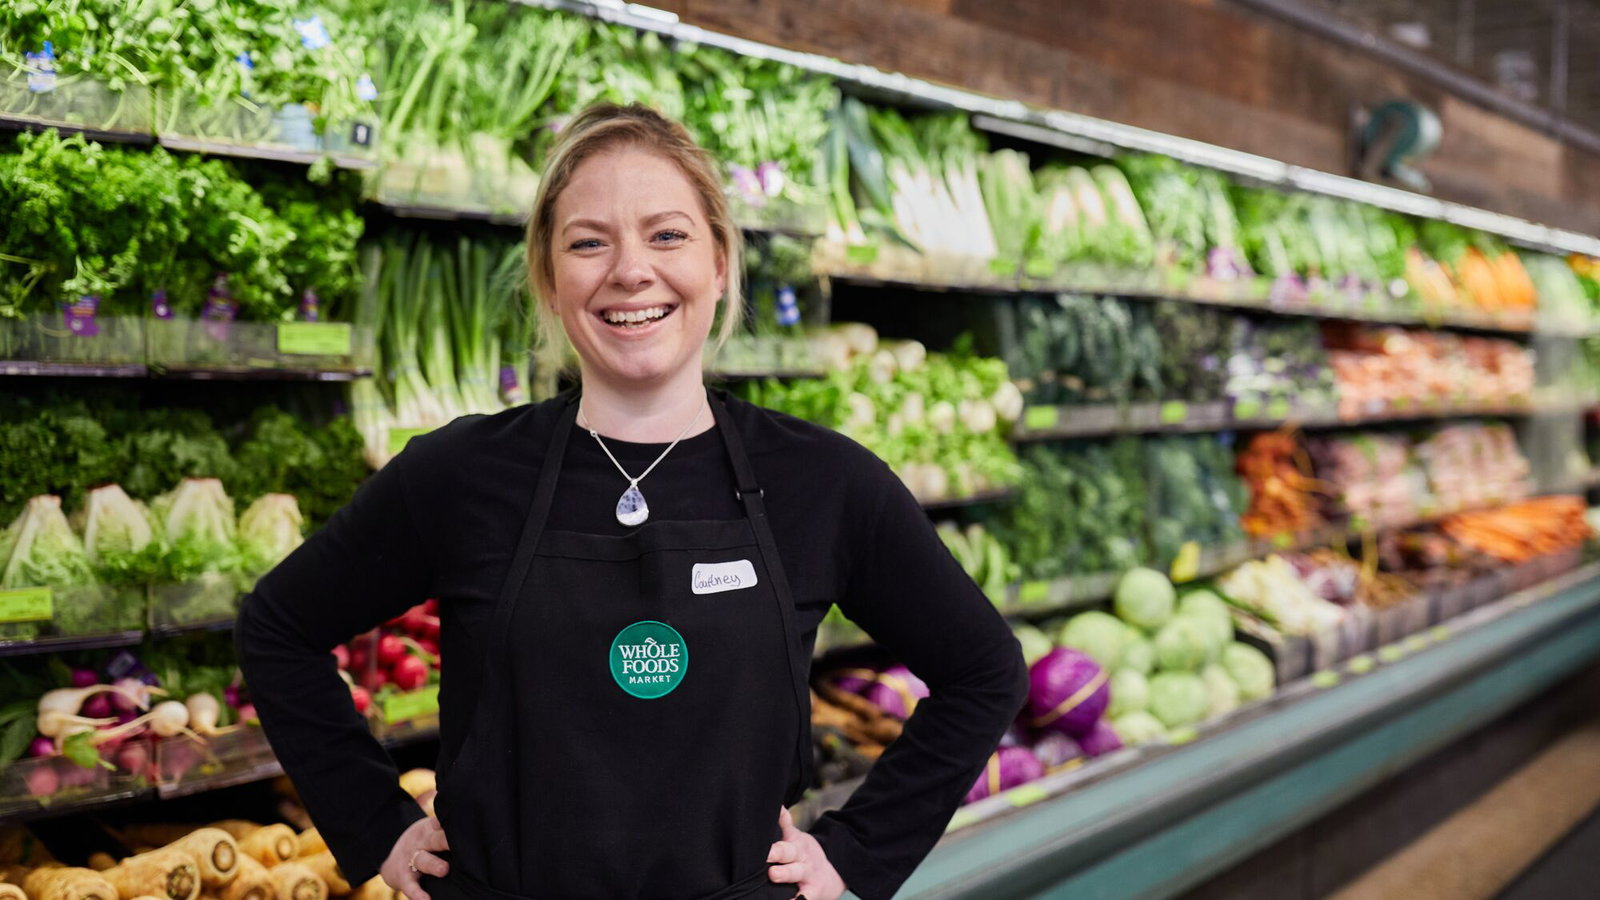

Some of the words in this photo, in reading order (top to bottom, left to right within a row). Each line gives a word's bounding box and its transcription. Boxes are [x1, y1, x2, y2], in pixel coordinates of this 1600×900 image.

[618, 642, 681, 659] WHOLE
[622, 658, 679, 674] FOODS
[629, 675, 671, 684] MARKET
